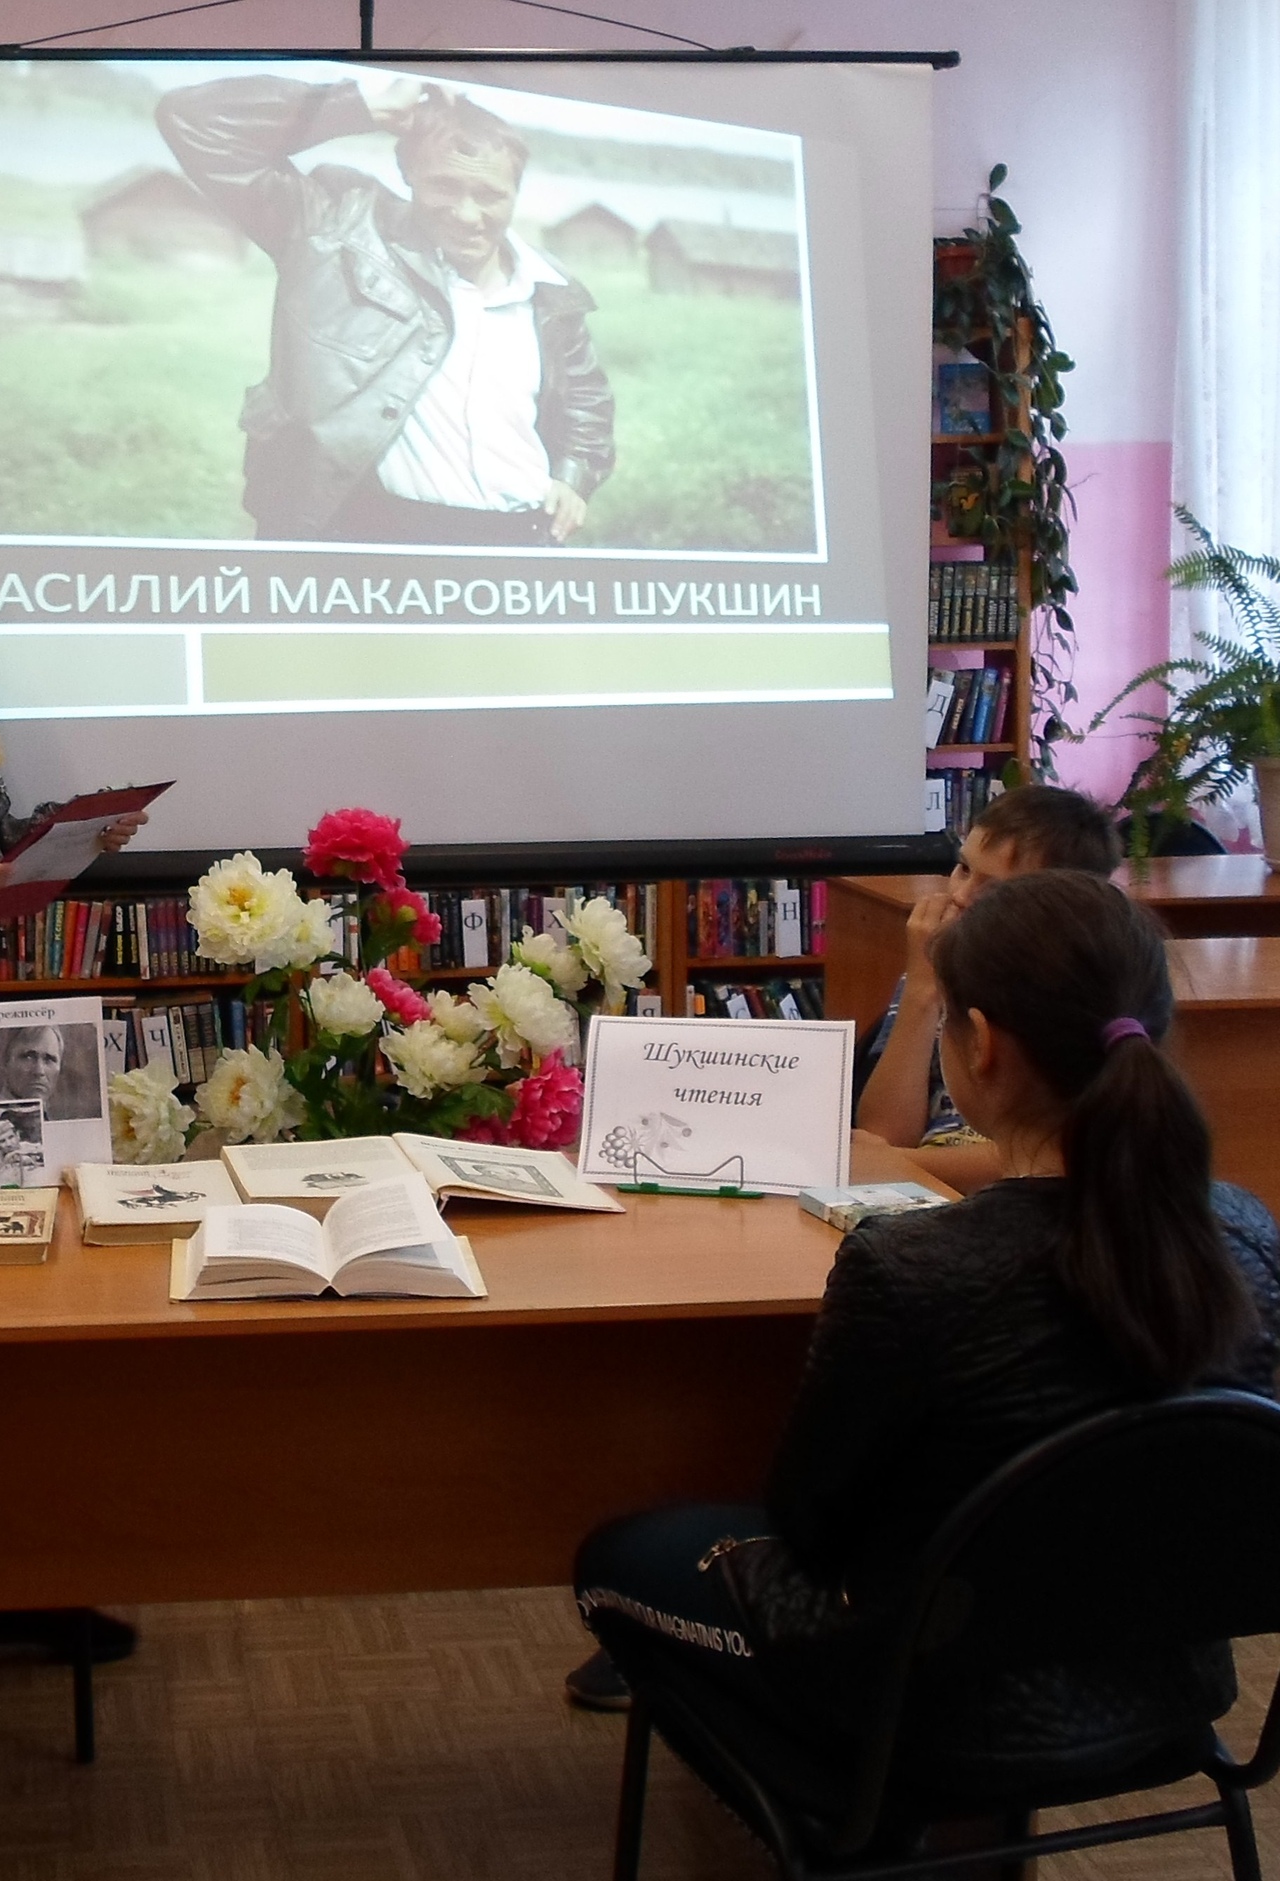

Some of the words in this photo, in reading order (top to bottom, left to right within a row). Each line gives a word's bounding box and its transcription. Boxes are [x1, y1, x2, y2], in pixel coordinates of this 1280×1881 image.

[269, 578, 596, 617] МАКАРОВИЧ
[614, 581, 823, 618] ШУКШИН
[928, 693, 948, 717] Д
[925, 791, 941, 811] Л
[463, 911, 483, 931] Ф
[781, 901, 799, 920] Н
[149, 1030, 167, 1048] Ч
[642, 1041, 801, 1074] Шукшинские
[673, 1085, 764, 1108] чтения
